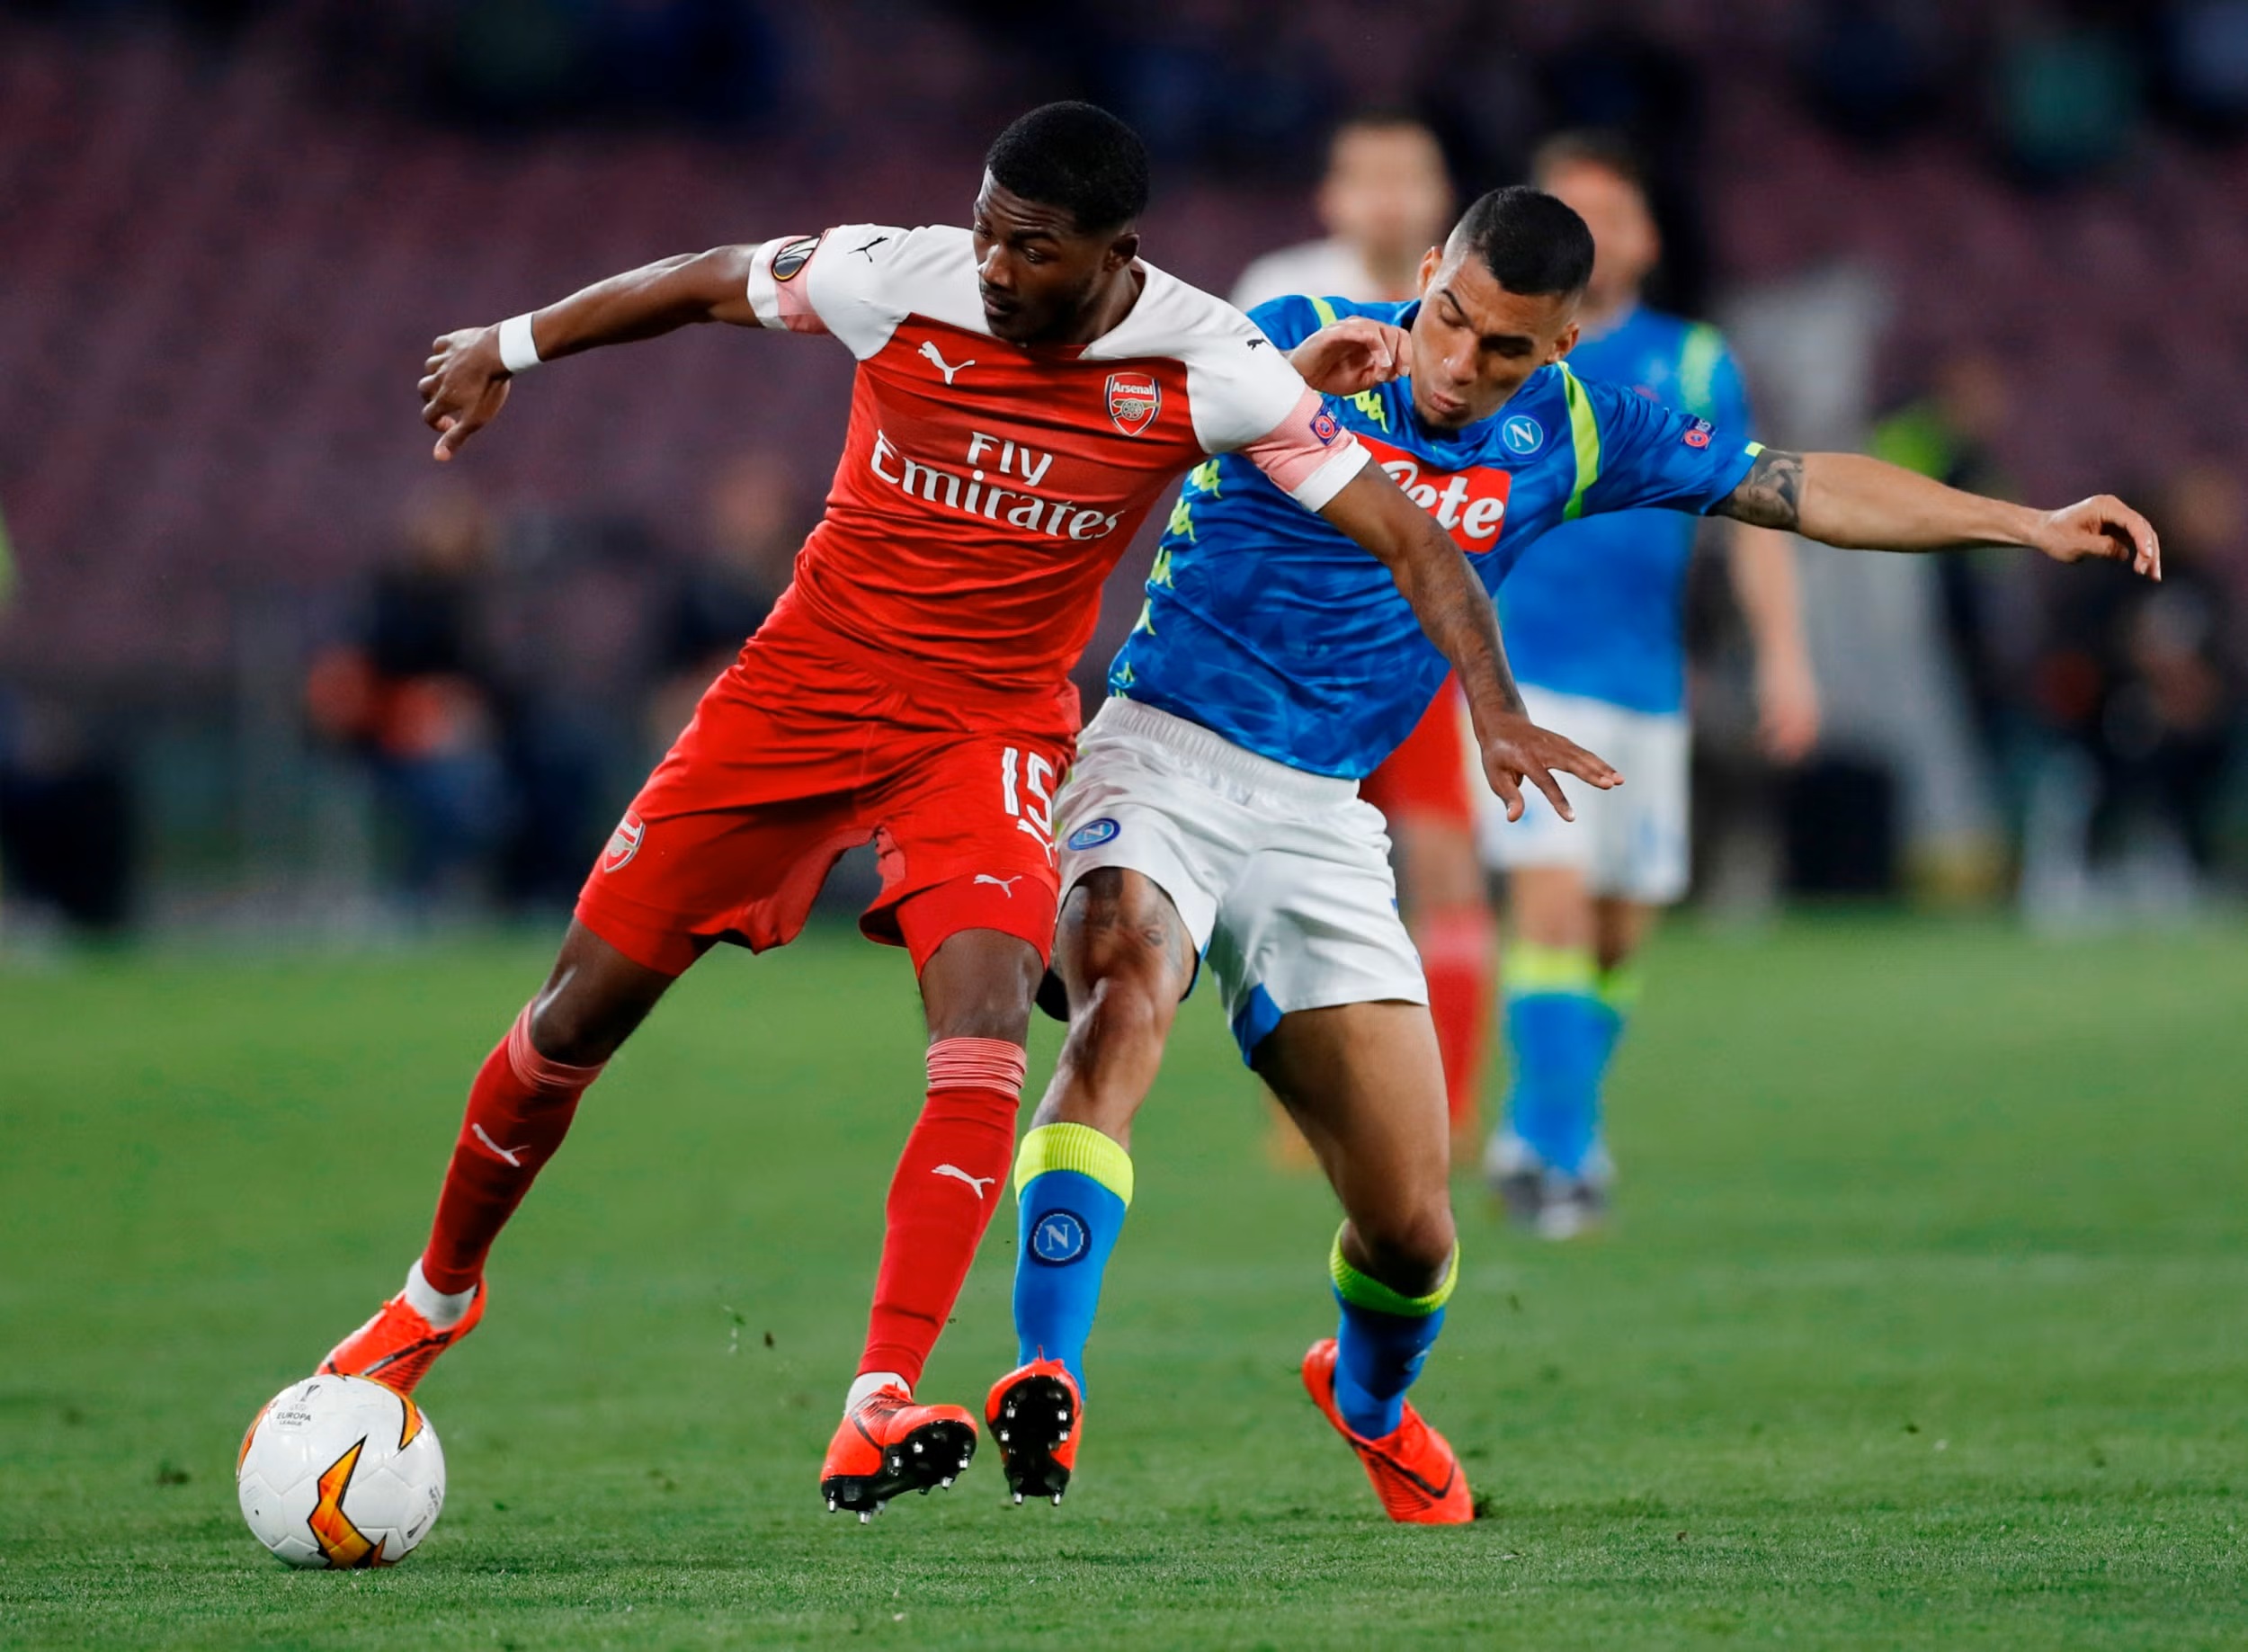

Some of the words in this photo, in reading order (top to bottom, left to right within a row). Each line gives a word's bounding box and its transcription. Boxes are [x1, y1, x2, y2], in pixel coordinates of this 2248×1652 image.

[1112, 381, 1154, 395] Arsenal
[1510, 422, 1535, 446] N
[967, 431, 1053, 487] Fly
[870, 428, 1126, 540] Emirates
[1002, 746, 1053, 836] 15
[1044, 1224, 1070, 1251] N
[276, 1412, 311, 1422] EUROPA
